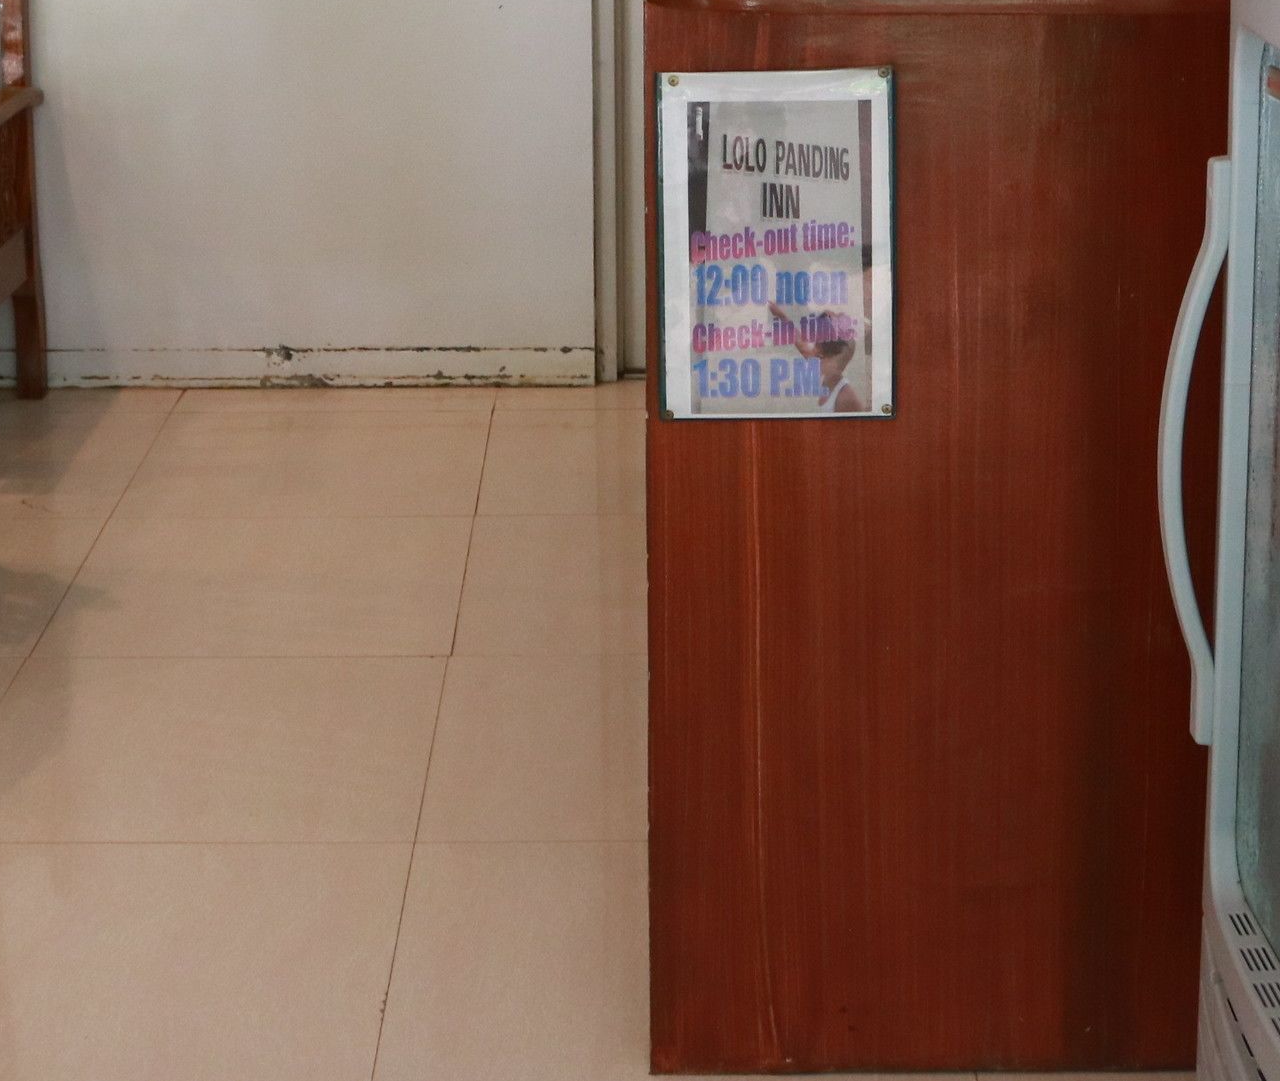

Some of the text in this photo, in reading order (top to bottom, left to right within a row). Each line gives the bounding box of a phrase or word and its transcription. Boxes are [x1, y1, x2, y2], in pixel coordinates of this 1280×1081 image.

[722, 134, 850, 181] LOLO PANDING
[761, 182, 801, 219] INN
[690, 219, 856, 264] Check-out time:
[694, 264, 849, 307] 12:00 noon
[692, 313, 858, 354] Check-in time:
[693, 357, 763, 398] 1:30
